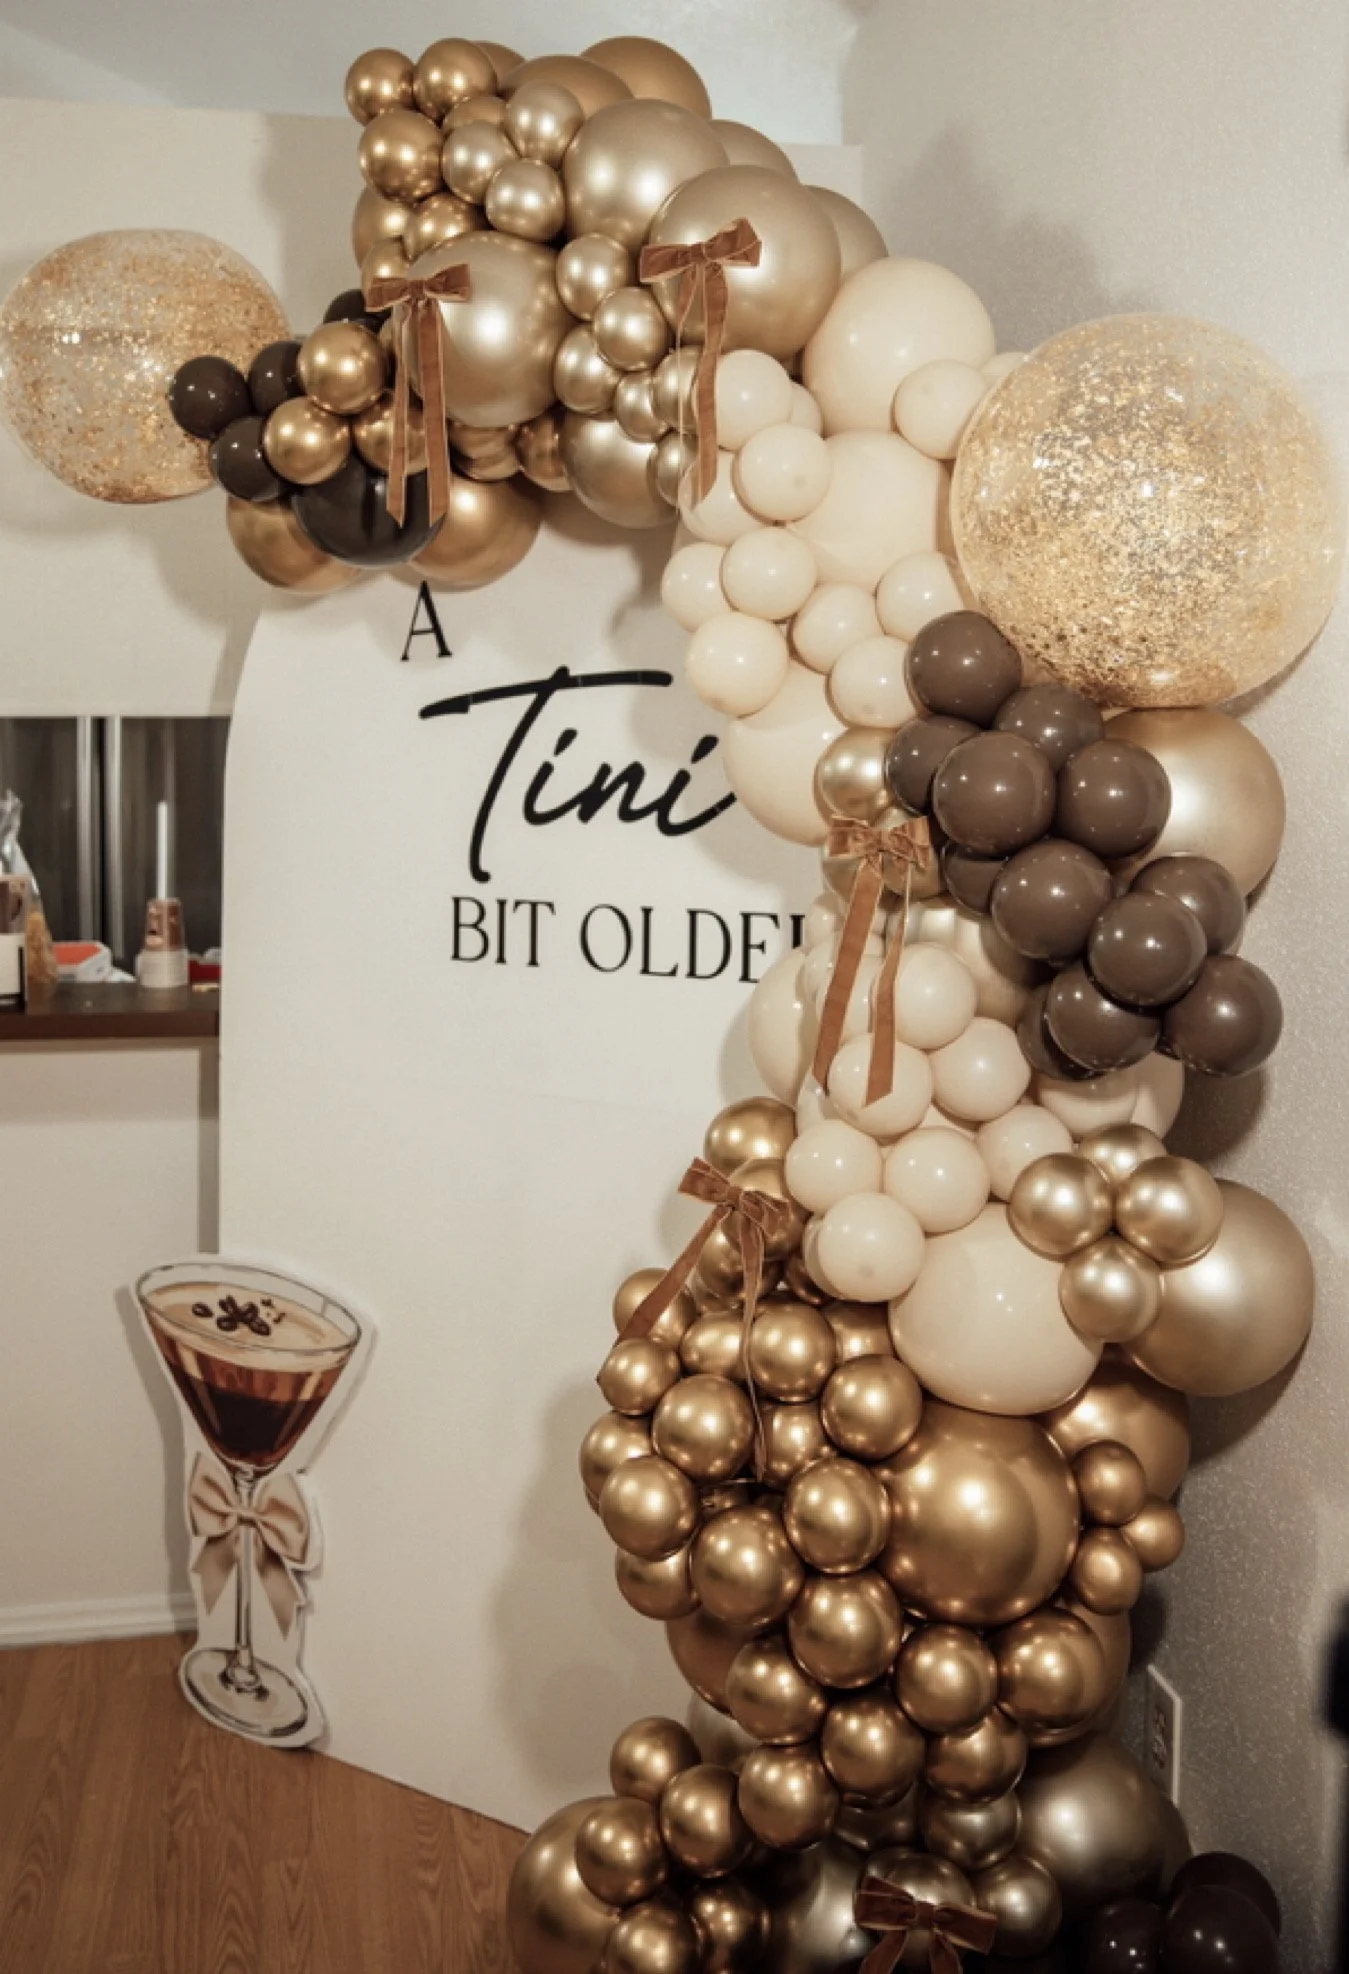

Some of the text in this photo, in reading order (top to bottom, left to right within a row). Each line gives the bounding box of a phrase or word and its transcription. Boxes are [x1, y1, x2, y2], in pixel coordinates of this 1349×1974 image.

[401, 580, 453, 661] A
[418, 665, 737, 883] Tini
[450, 896, 806, 983] BIT OLDE
